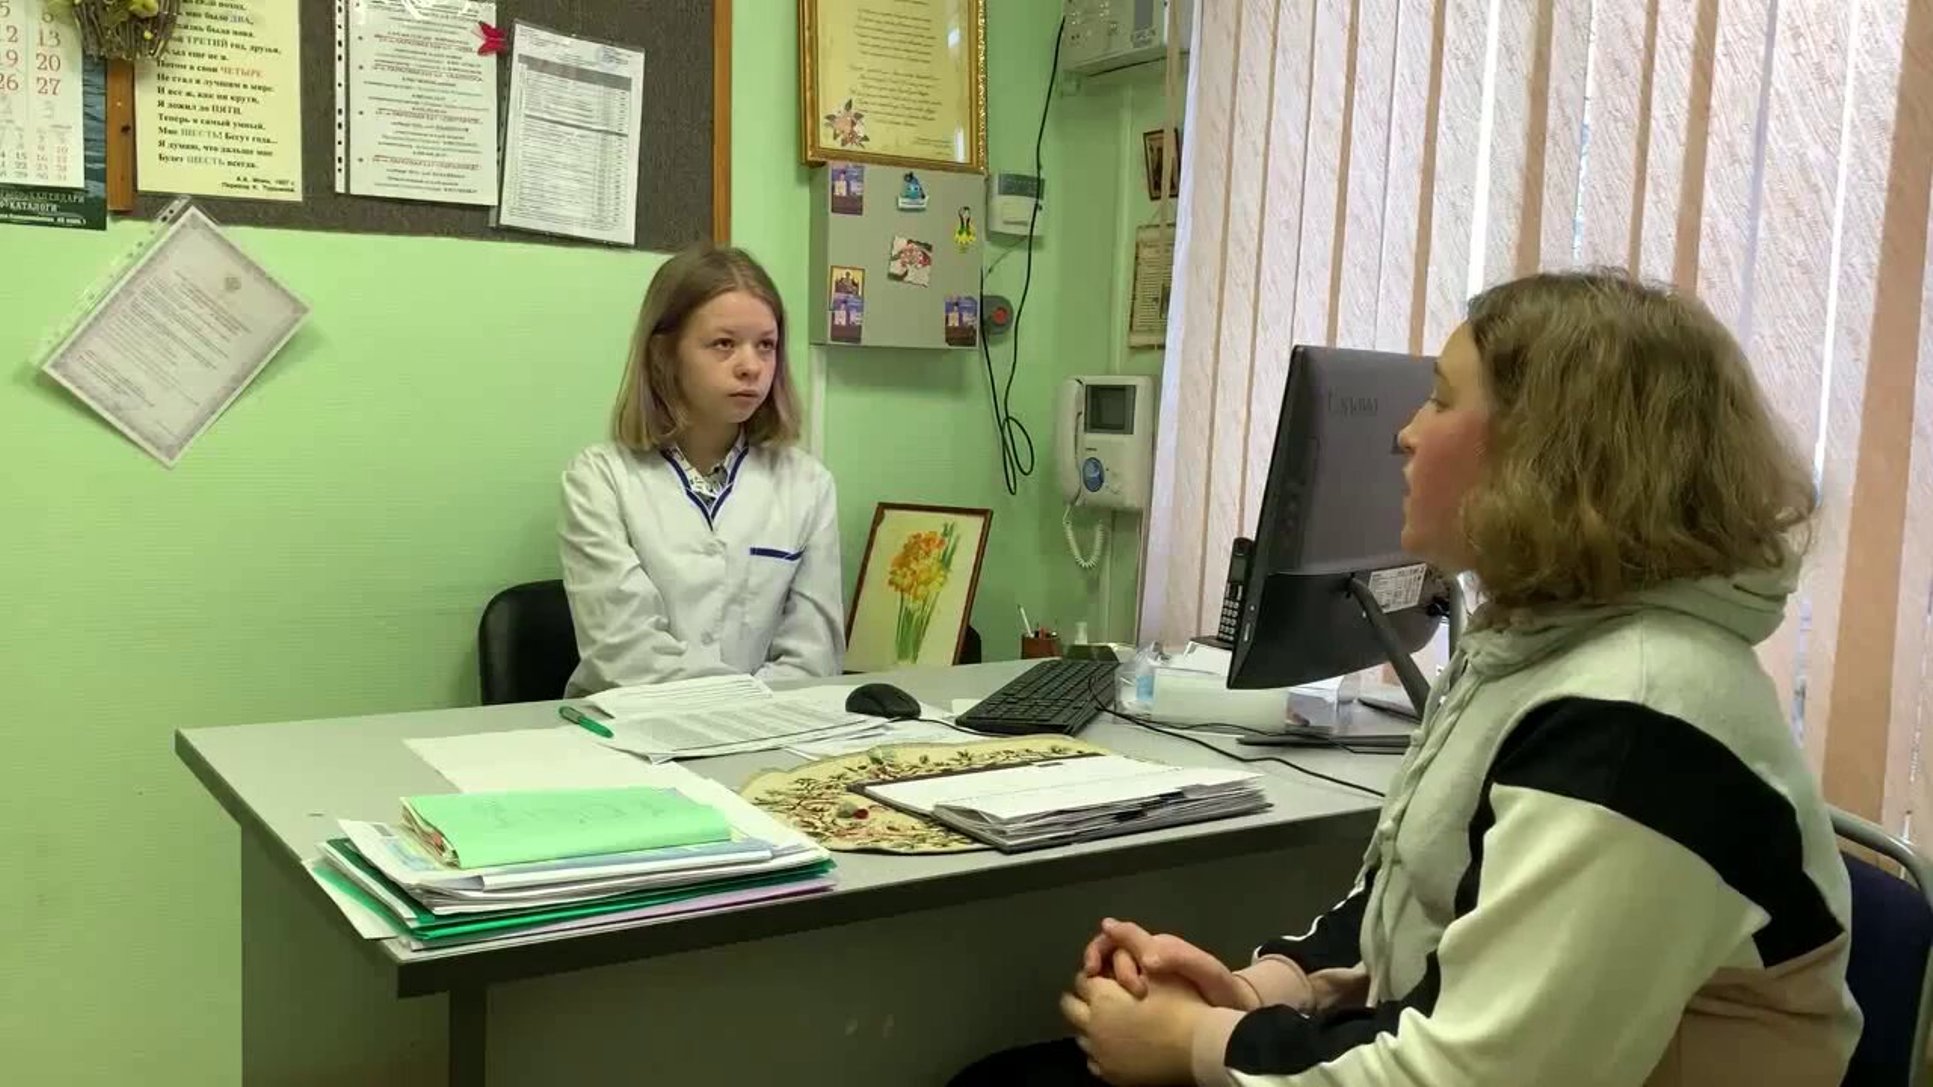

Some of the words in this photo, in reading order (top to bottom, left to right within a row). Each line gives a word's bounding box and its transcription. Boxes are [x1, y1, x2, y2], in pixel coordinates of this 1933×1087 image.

[0, 25, 18, 43] 2
[38, 28, 61, 47] 13
[186, 36, 228, 48] ТРЕТИЙ
[0, 49, 18, 67] 9
[36, 53, 61, 72] 20
[157, 73, 169, 82] Не
[36, 76, 61, 96] 27
[157, 86, 165, 94] И
[157, 100, 165, 108] Я
[158, 113, 191, 125] Теперь
[200, 117, 230, 127] самый
[158, 126, 178, 135] Мне
[158, 140, 166, 148] Я
[9, 201, 58, 212] КАТАЛОГИ
